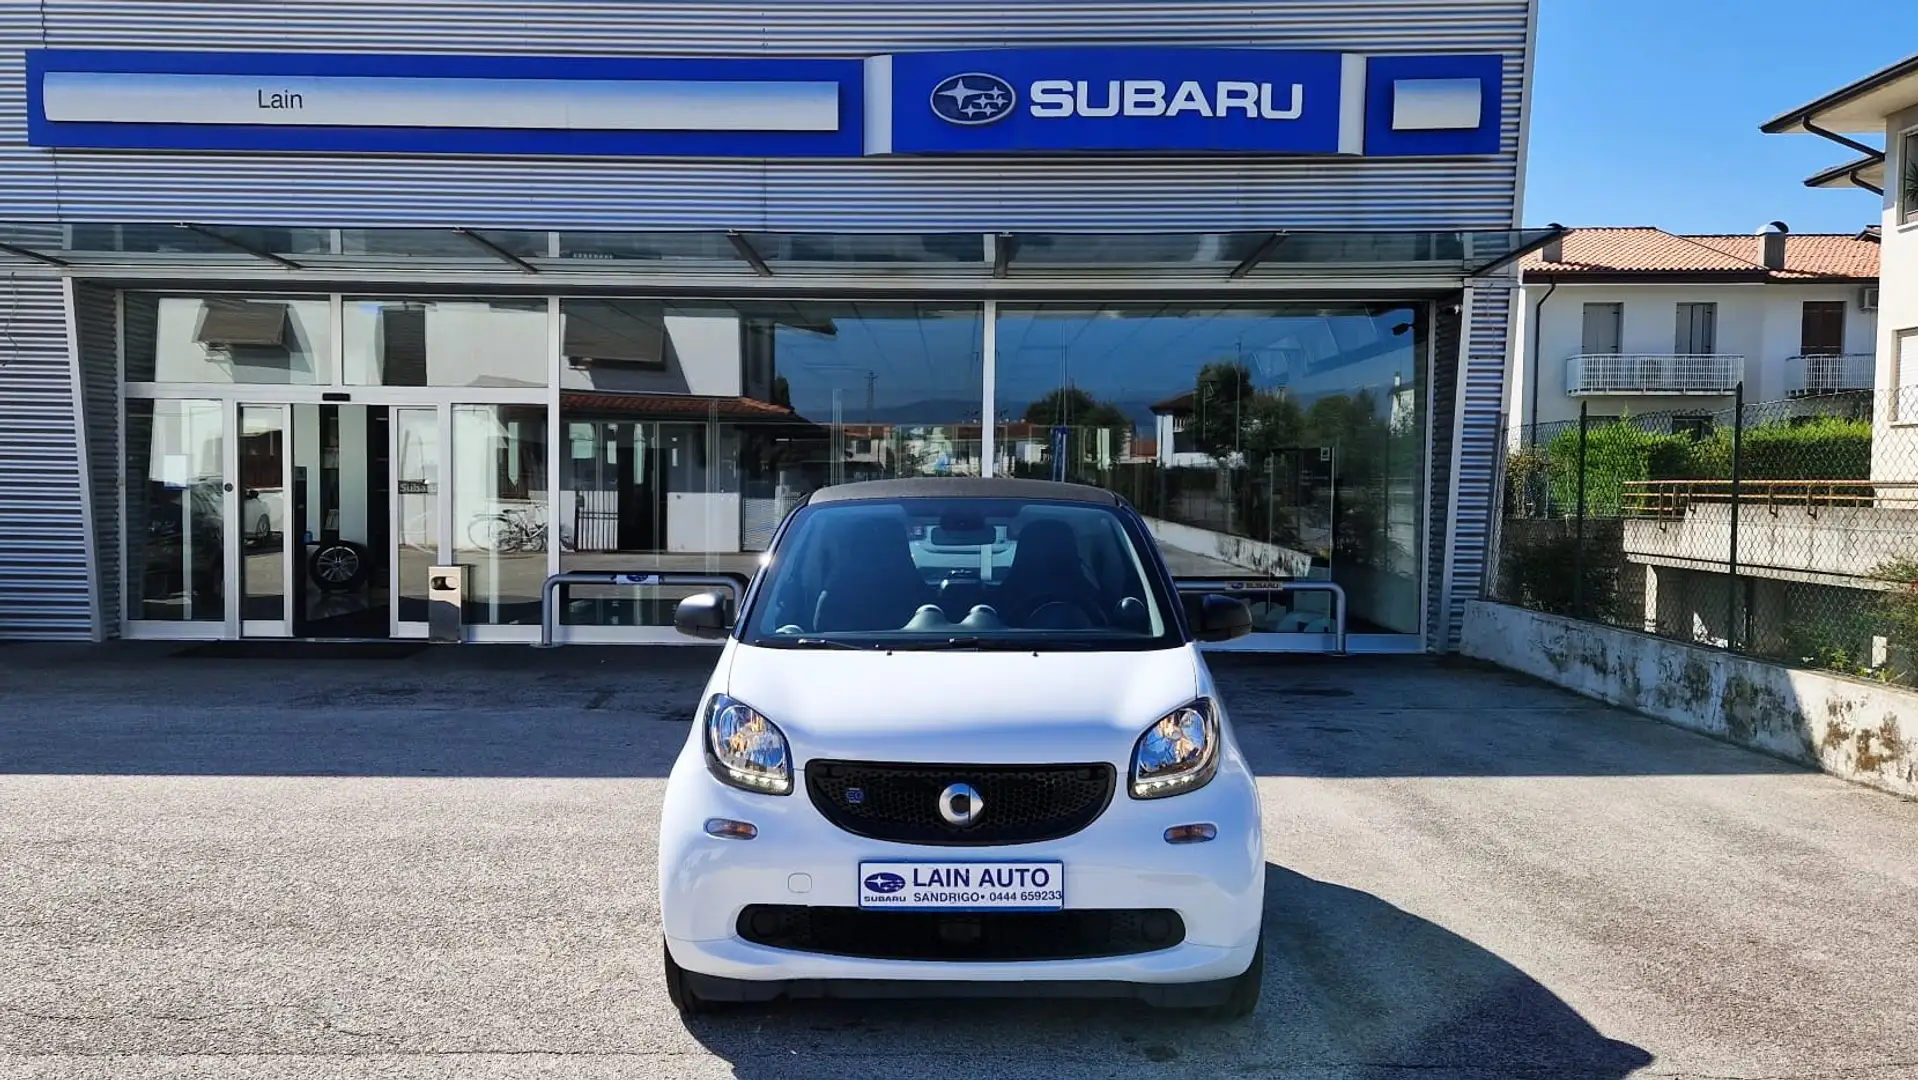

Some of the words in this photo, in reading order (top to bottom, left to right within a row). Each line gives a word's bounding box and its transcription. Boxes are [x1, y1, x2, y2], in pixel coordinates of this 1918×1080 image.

[258, 88, 303, 109] Lain
[1030, 80, 1303, 120] SUBARU
[913, 868, 970, 887] LAIN
[978, 868, 1050, 887] AUTO
[989, 891, 1017, 901] 0444
[1020, 890, 1062, 901] 659233
